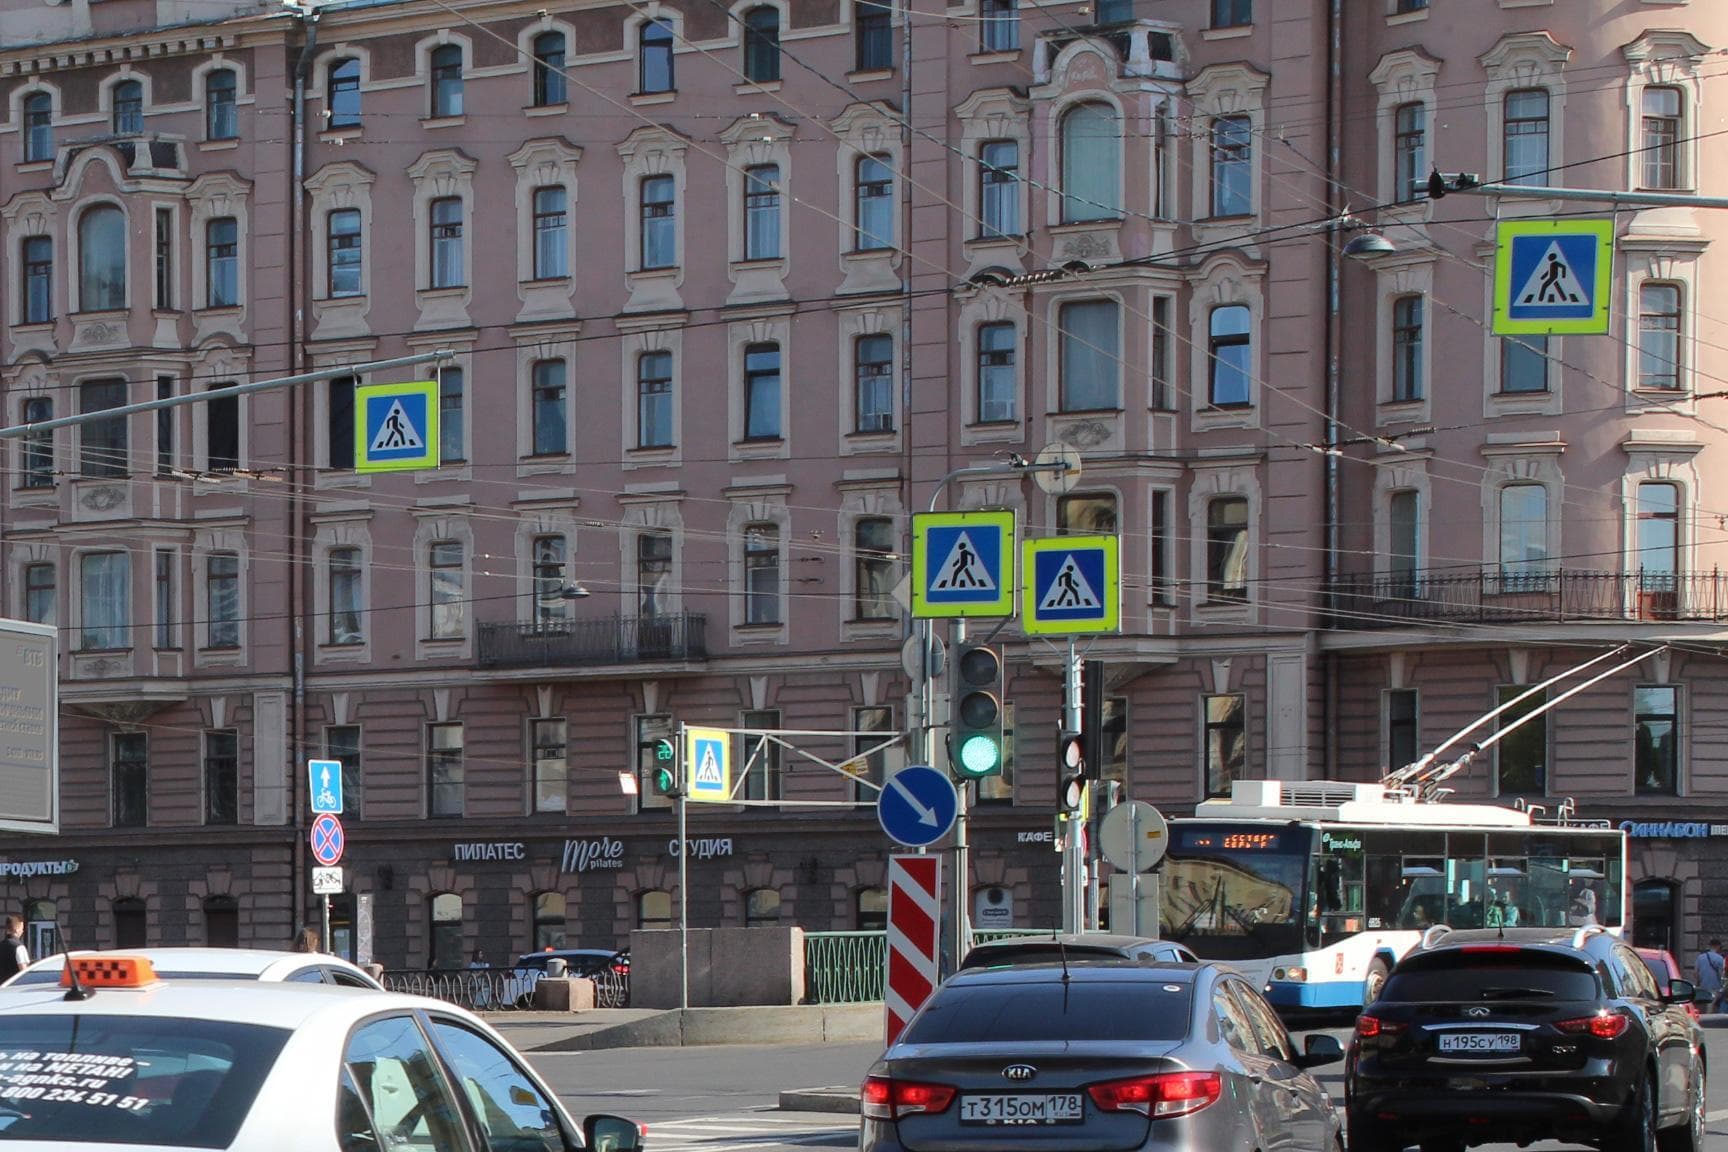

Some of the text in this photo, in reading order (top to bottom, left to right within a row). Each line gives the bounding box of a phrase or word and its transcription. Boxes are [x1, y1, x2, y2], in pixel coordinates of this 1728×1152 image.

[1017, 831, 1053, 842] КАФЕ
[454, 842, 526, 861] ПИЛАТЕС
[668, 838, 733, 860] СУДИЯ
[590, 858, 623, 870] pilates
[1443, 1035, 1518, 1049] Н195СУ 198
[10, 1051, 41, 1061] на
[42, 1052, 134, 1067] топливе
[13, 1062, 43, 1073] на
[43, 1062, 134, 1079] МЕТАН!
[1007, 1067, 1032, 1079] KIA
[1, 1086, 46, 1100] 800
[85, 1091, 120, 1107] 51
[115, 1095, 150, 1111] 51
[967, 1095, 1078, 1117] Т315ОМ 178
